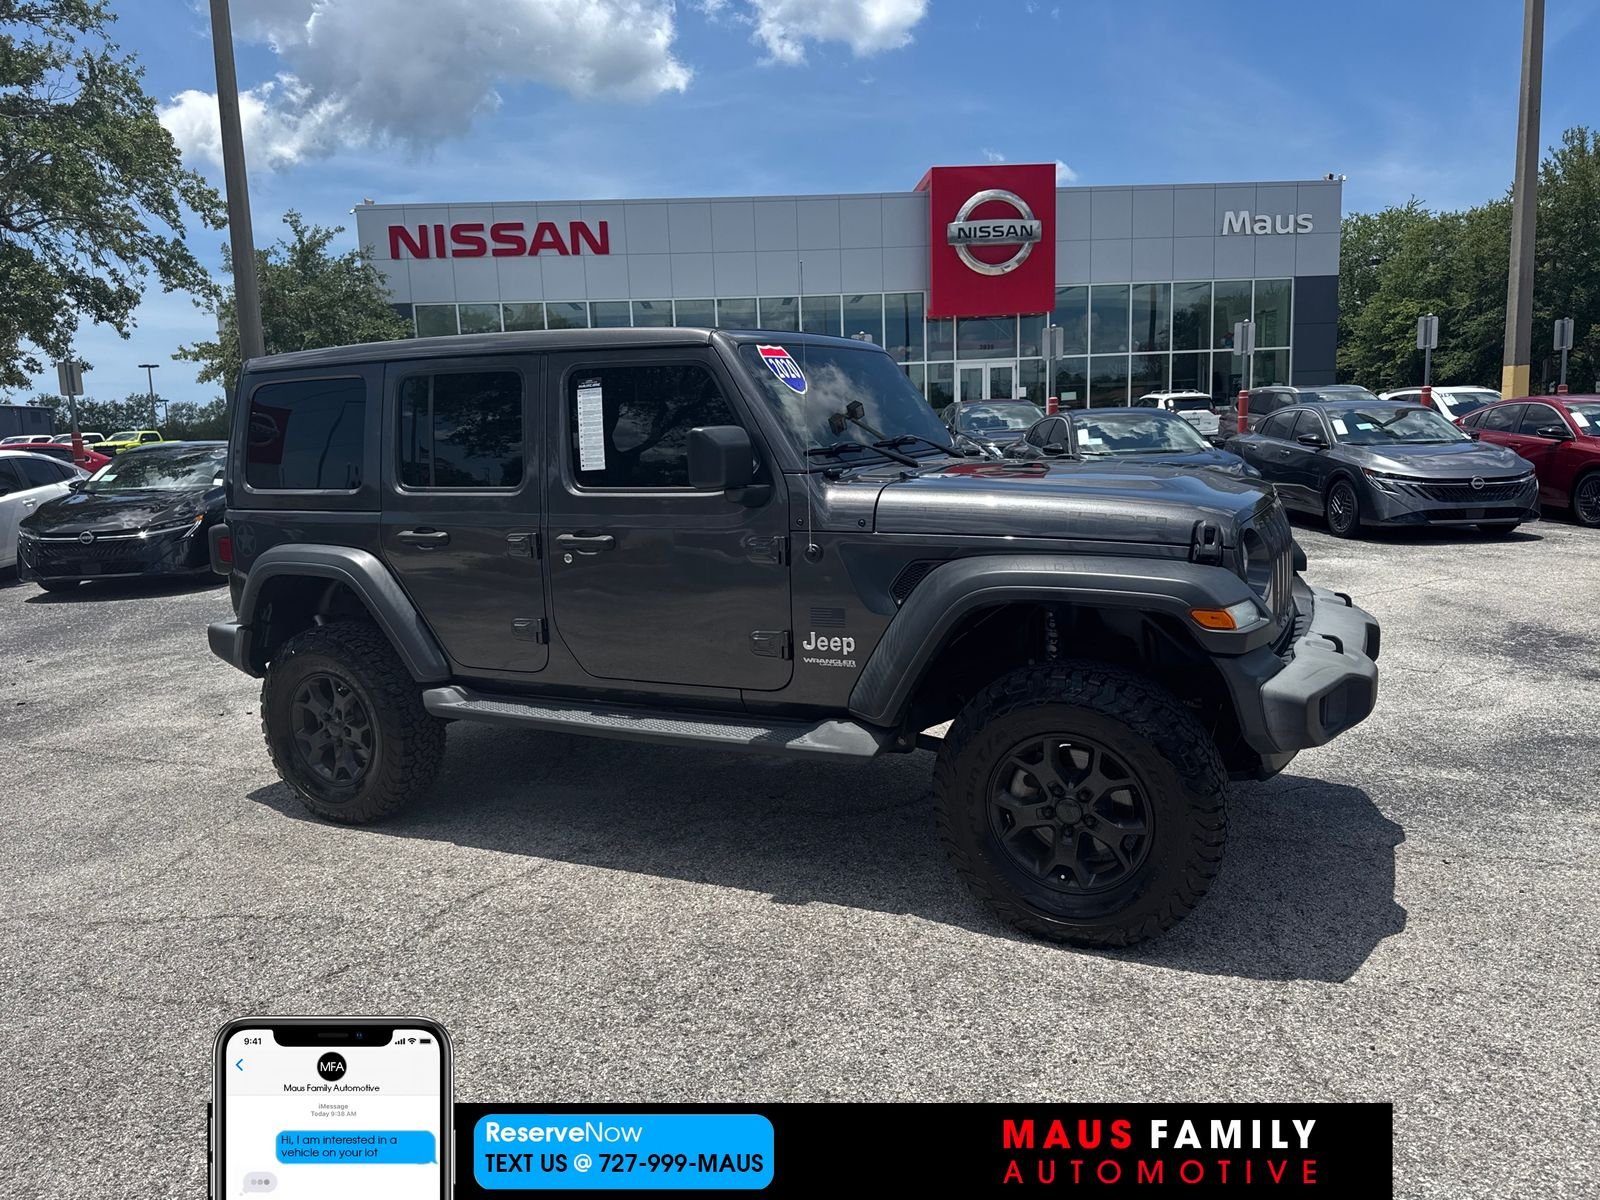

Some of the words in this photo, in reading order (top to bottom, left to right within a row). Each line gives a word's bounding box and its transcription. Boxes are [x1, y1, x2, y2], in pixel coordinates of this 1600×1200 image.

[957, 224, 1033, 240] NISSAN
[1221, 209, 1314, 236] Maus
[389, 220, 610, 260] NISSAN
[768, 358, 801, 379] 2020
[802, 631, 855, 655] Jeep
[802, 656, 856, 665] WRANGLER
